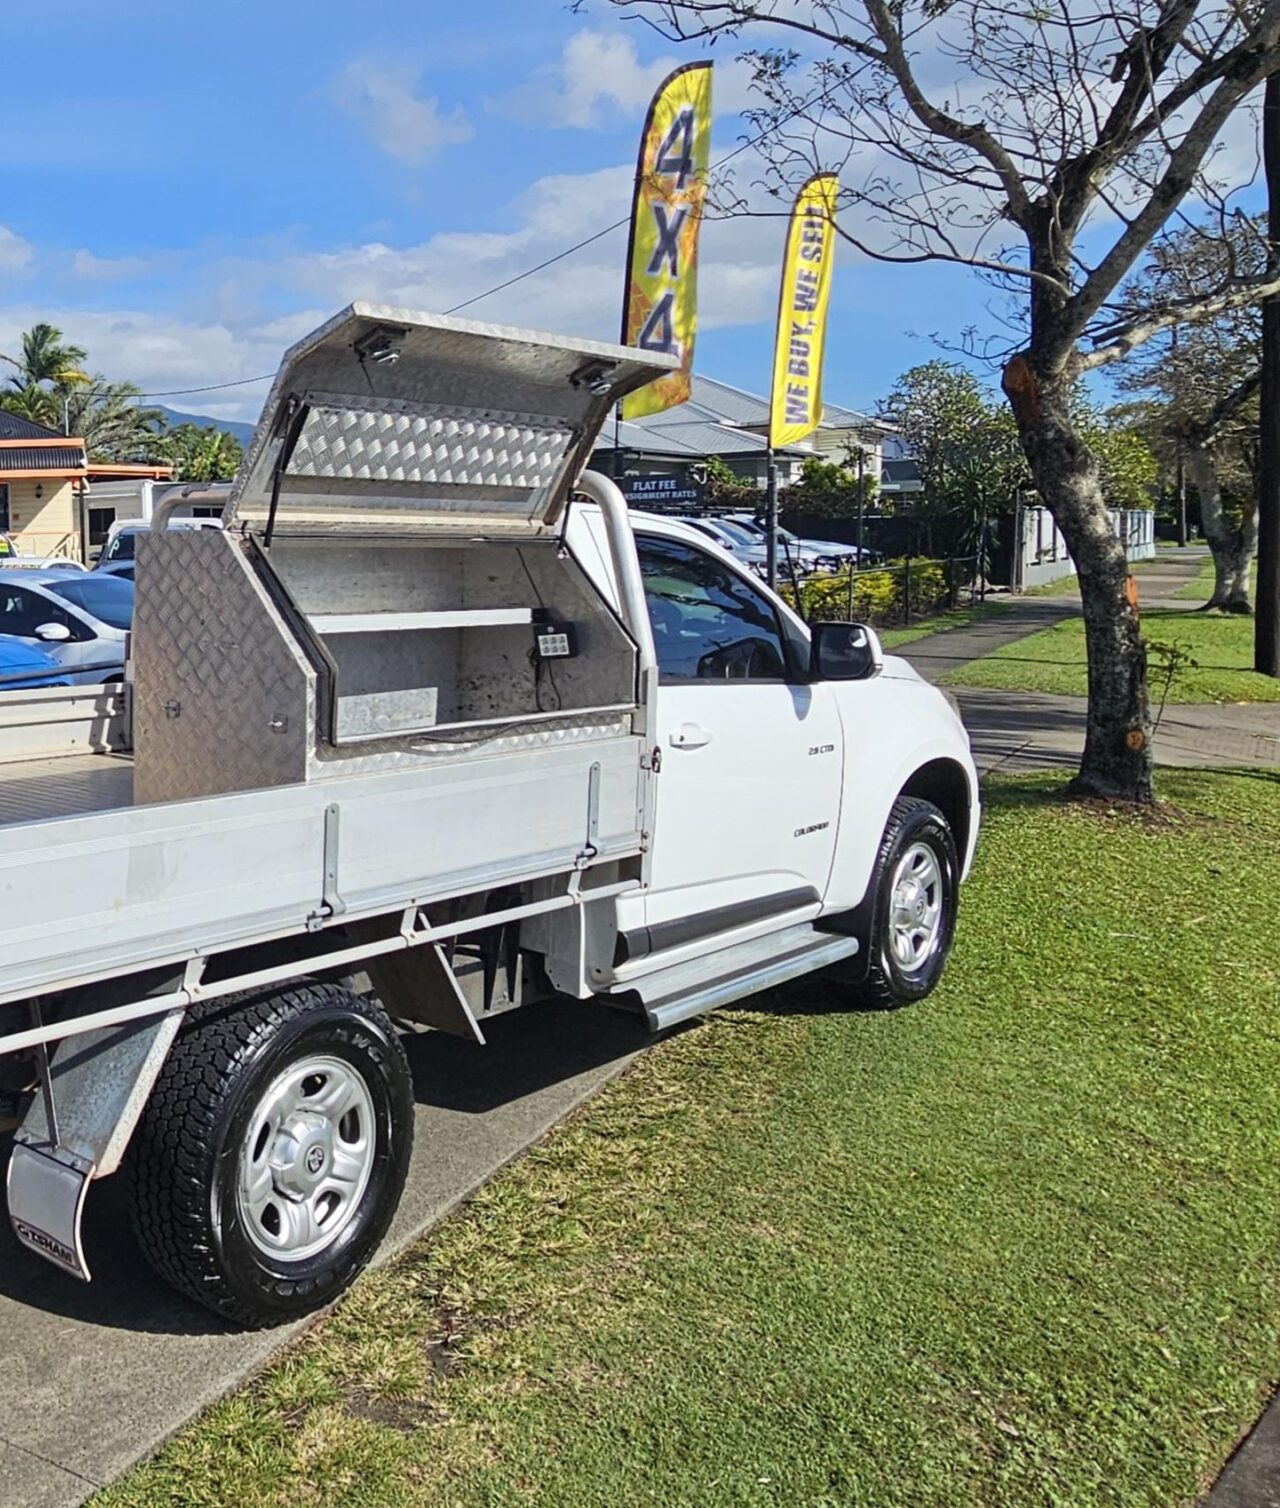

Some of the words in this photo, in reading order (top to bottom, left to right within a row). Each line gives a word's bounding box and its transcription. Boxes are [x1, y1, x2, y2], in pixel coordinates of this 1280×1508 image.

[794, 268, 819, 312] WE
[788, 320, 817, 377] BUY,
[785, 382, 809, 423] WE
[633, 482, 656, 491] FLAT
[658, 480, 677, 490] FEE
[672, 490, 697, 498] RATES
